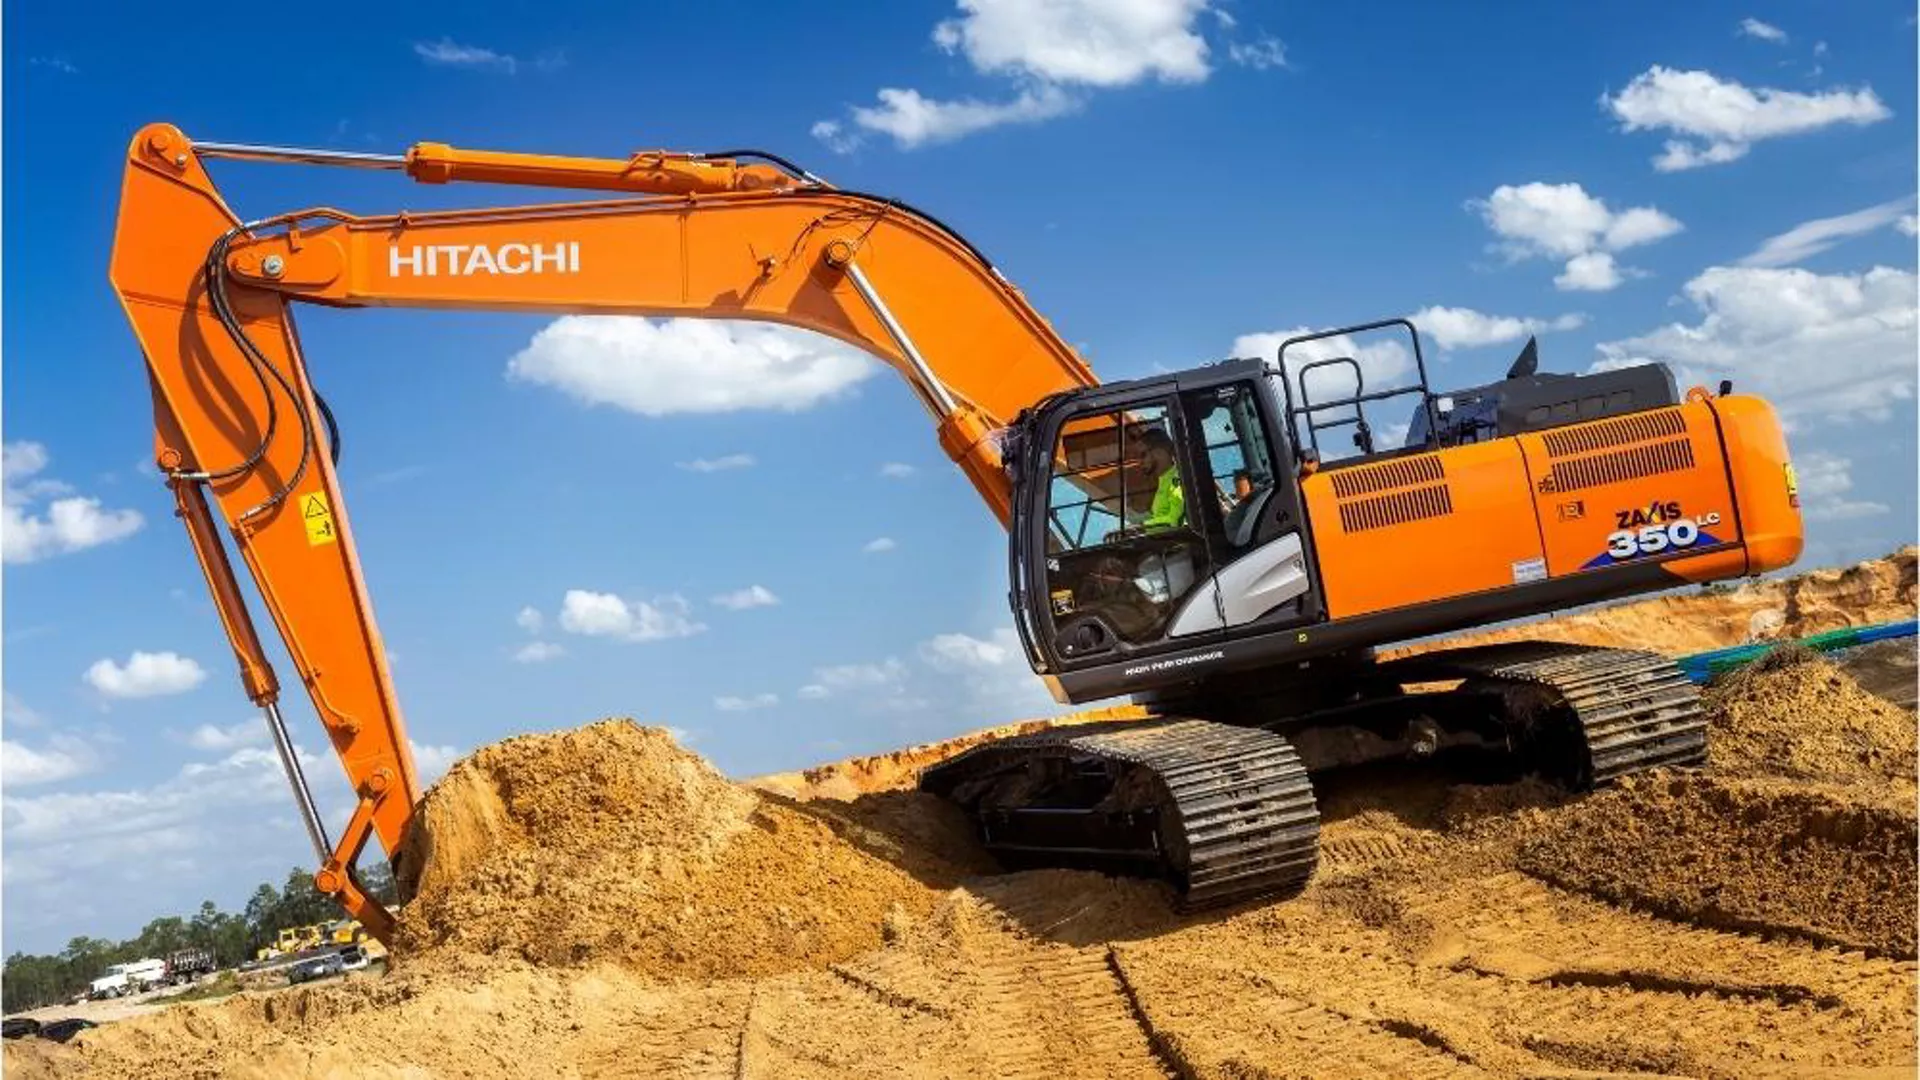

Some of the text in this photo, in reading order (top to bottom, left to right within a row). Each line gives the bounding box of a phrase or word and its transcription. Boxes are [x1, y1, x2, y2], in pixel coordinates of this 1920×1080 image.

[388, 241, 580, 277] HITACHI
[1616, 501, 1682, 528] ZAXIS
[1607, 518, 1698, 559] 350
